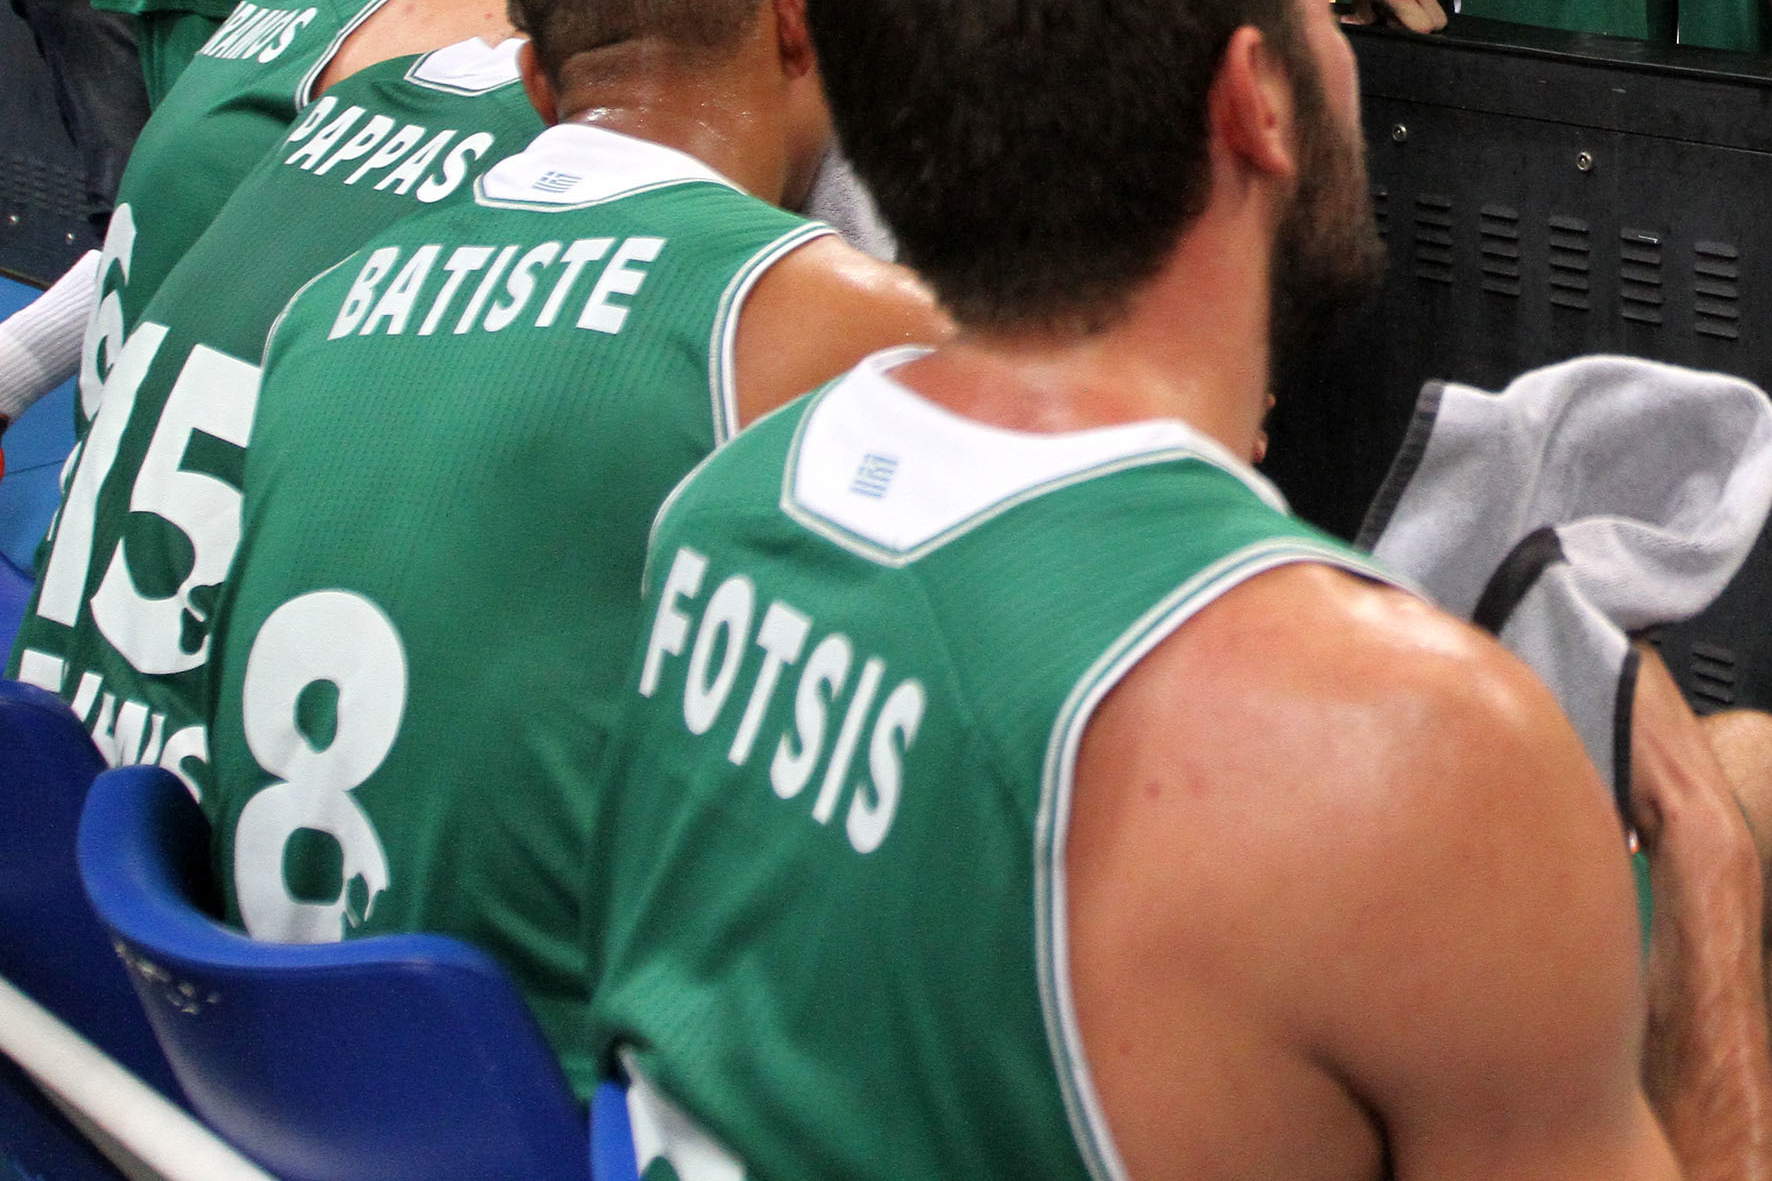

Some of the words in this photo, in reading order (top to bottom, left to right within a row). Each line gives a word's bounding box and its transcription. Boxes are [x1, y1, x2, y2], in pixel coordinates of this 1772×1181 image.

[195, 0, 318, 64] RAMOS
[285, 96, 494, 203] PAPPAS
[327, 237, 668, 341] BATISTE
[36, 321, 264, 675] 15
[235, 591, 408, 944] 8
[638, 546, 926, 854] FOTSIS
